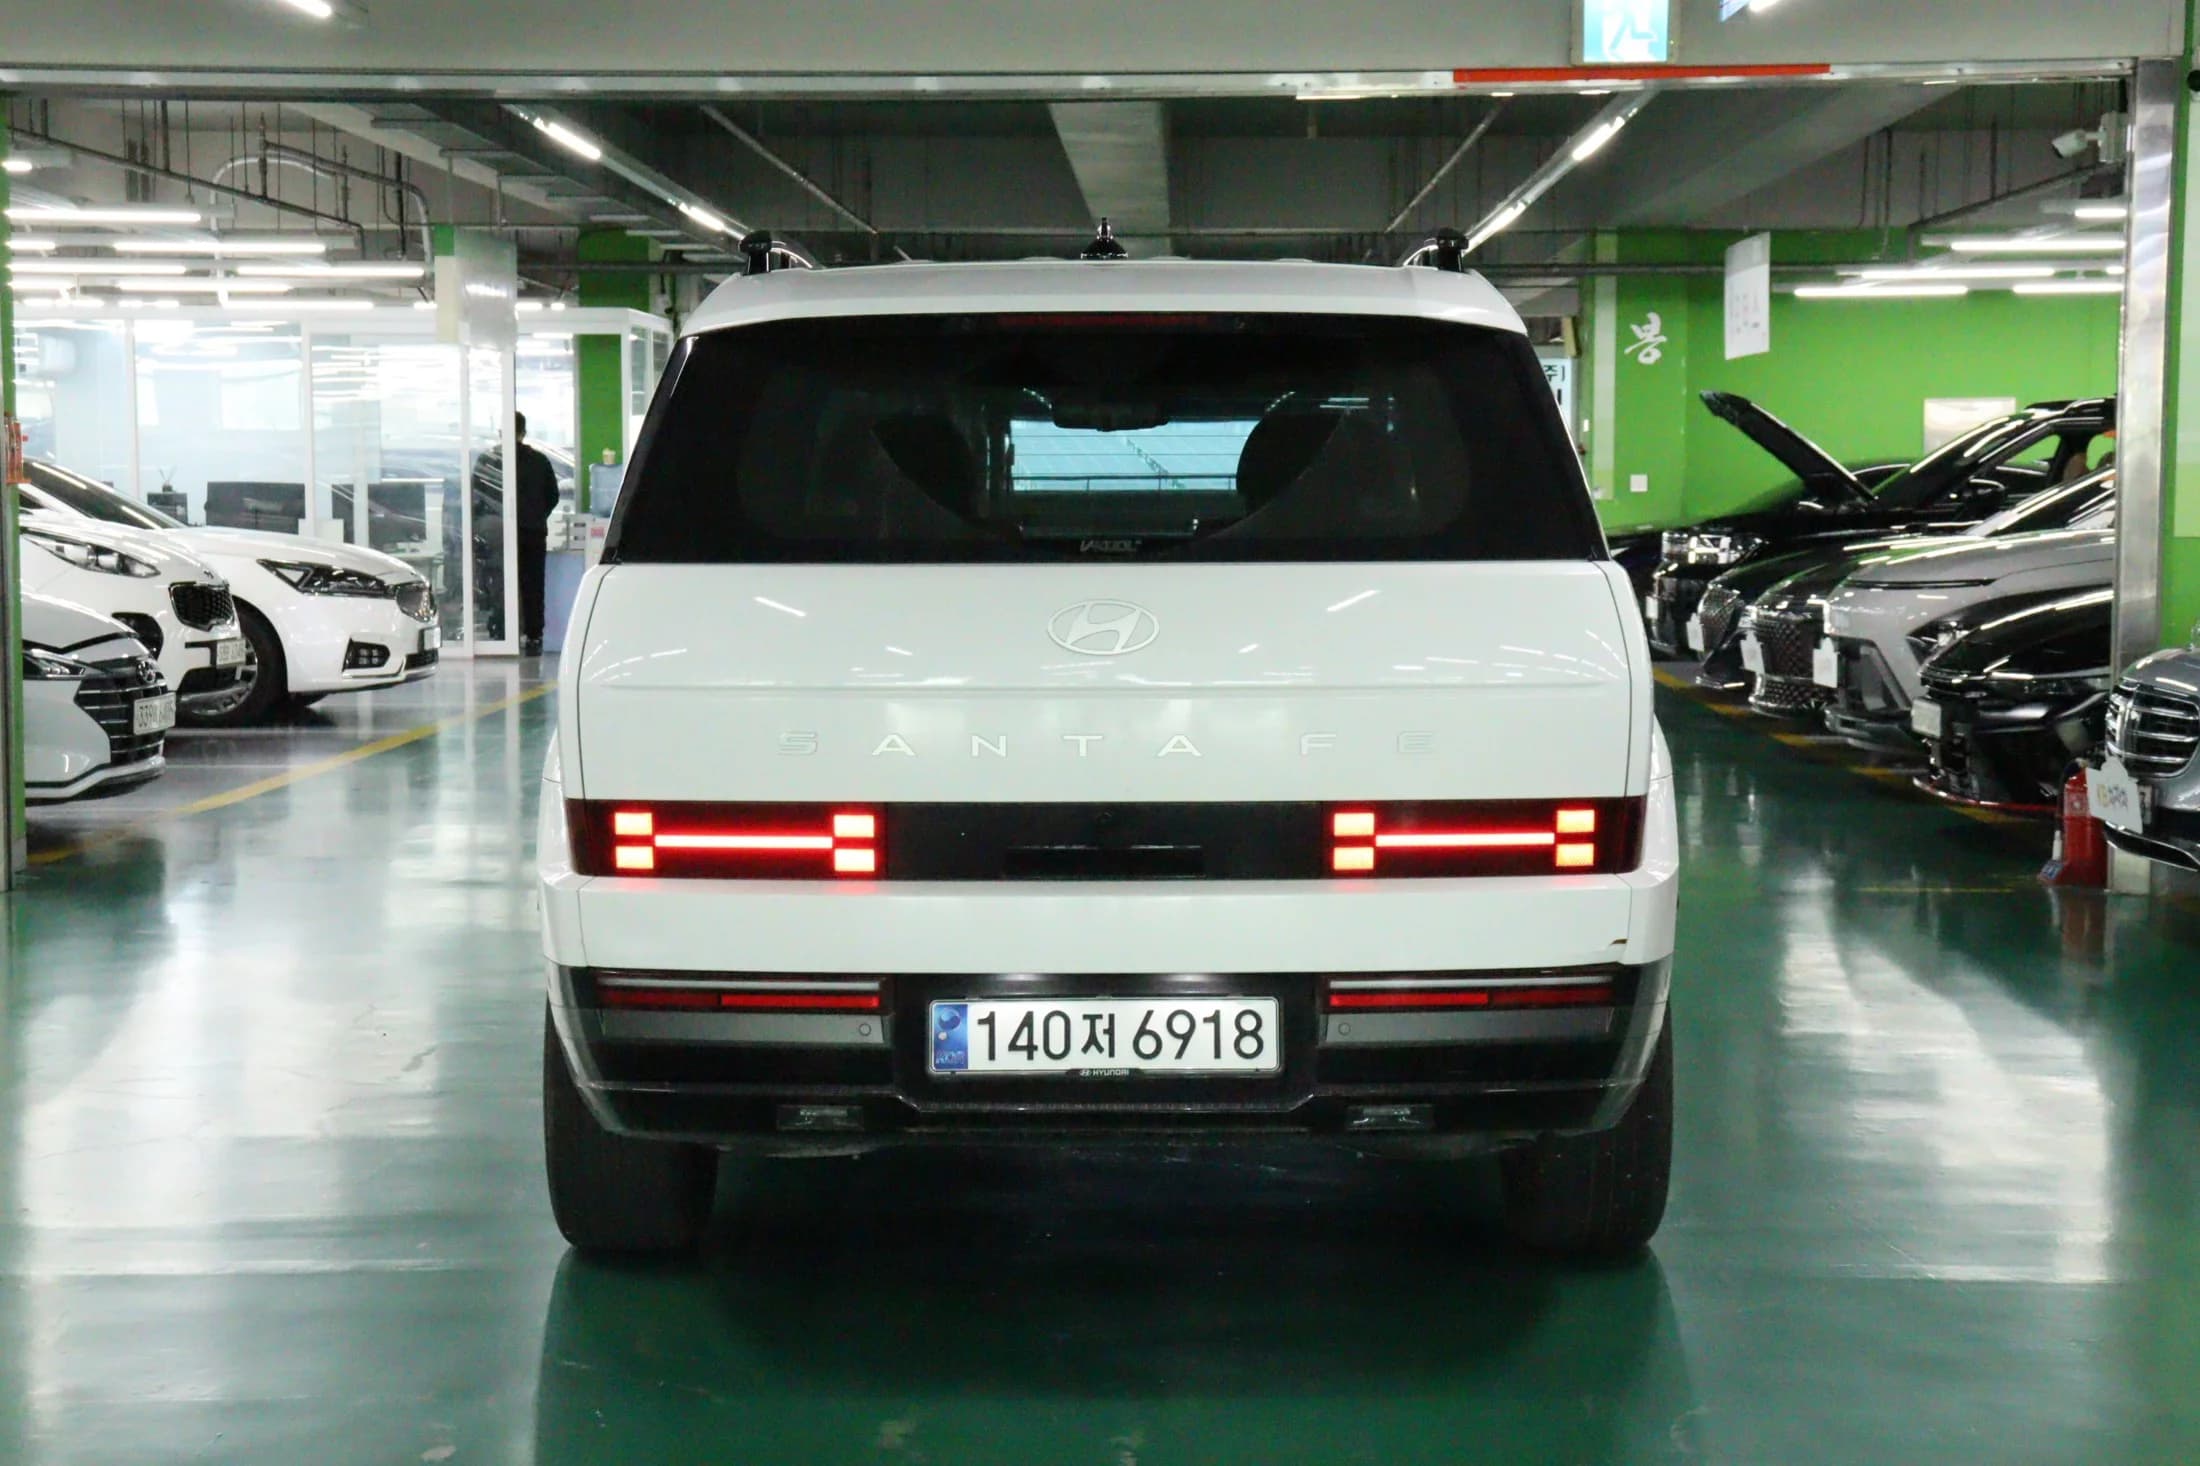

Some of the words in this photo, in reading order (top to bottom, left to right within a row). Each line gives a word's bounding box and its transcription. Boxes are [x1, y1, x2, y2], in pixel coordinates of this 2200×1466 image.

[1543, 364, 1566, 382] 주)
[778, 732, 1202, 758] SANTA
[1298, 730, 1436, 756] FE
[976, 1009, 1116, 1062] 140저
[1132, 1008, 1265, 1061] 6918
[1091, 1068, 1130, 1078] HYUNDAI
